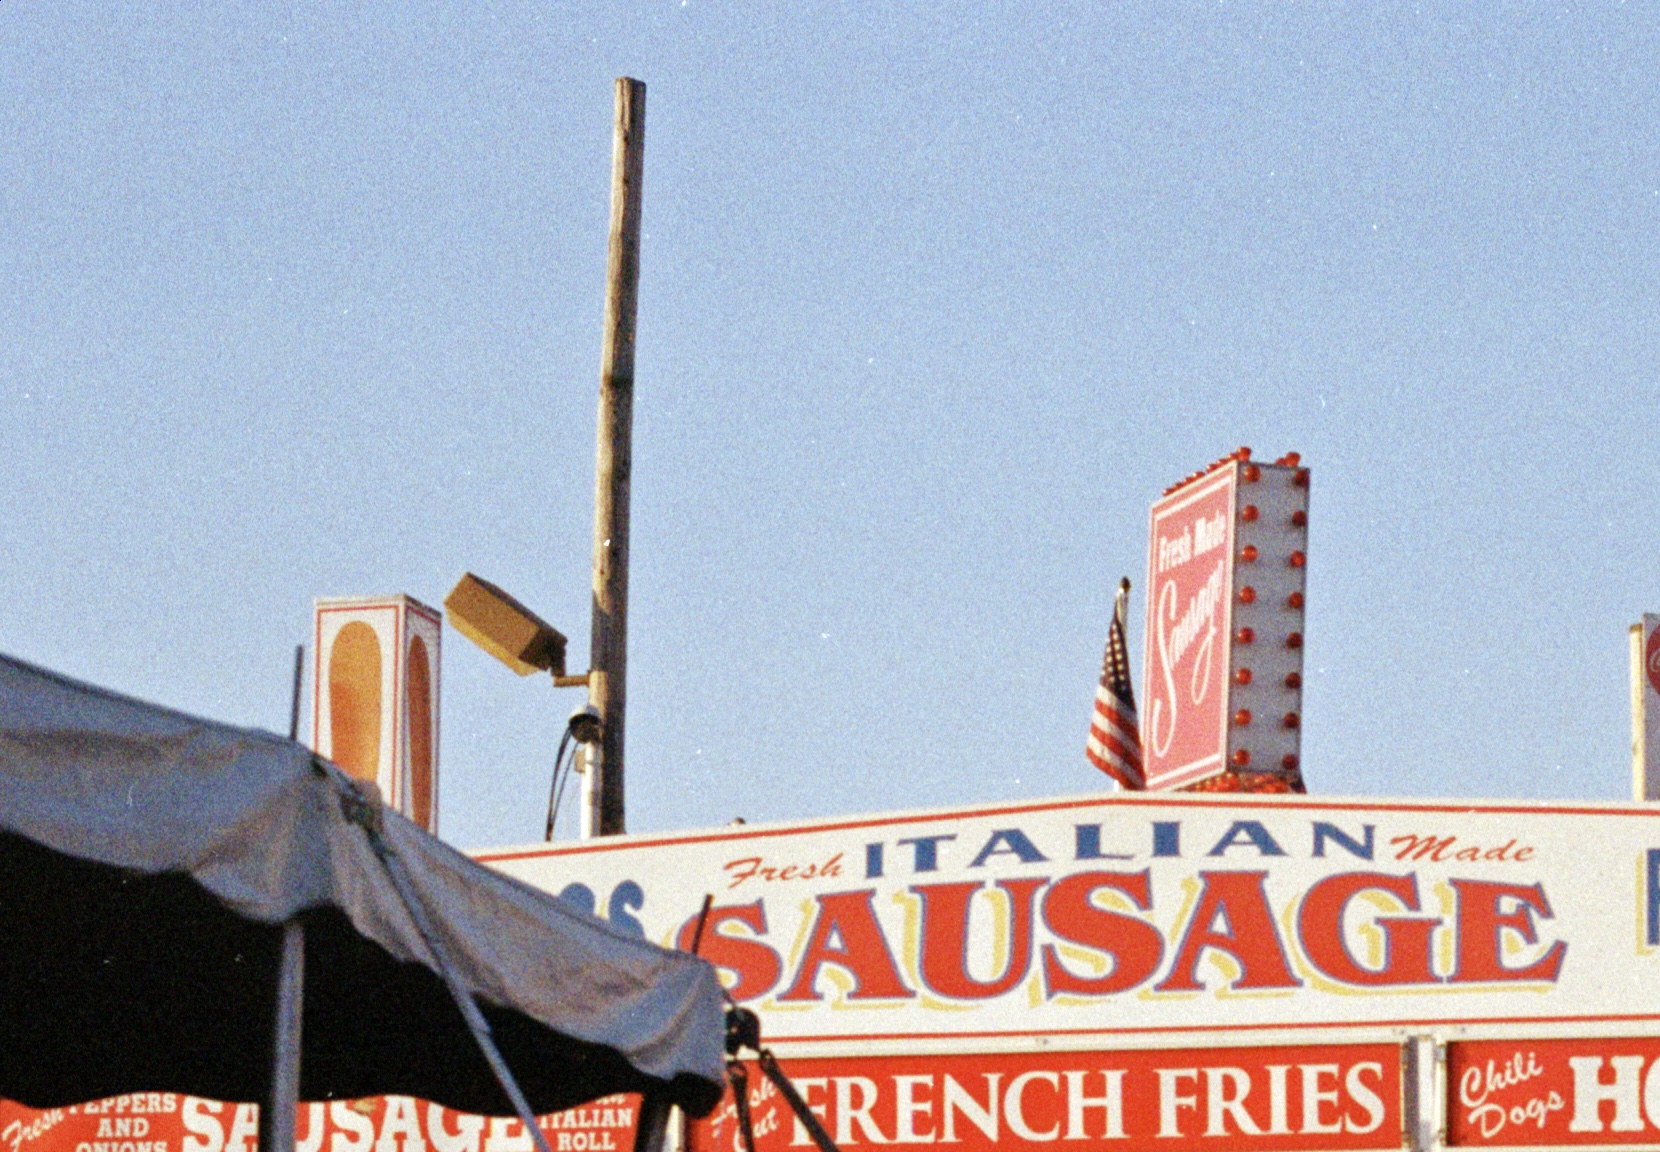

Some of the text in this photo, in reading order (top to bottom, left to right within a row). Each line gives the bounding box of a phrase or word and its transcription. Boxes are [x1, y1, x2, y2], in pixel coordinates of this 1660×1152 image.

[724, 820, 1537, 888] Fresh ITALIAN Made
[676, 867, 1569, 1002] SAUSAGE
[788, 1060, 1385, 1147] FRENCH FRIES
[1460, 1051, 1543, 1108] Chili
[97, 1117, 149, 1138] AND
[557, 1132, 616, 1152] ROLL
[1469, 1090, 1565, 1139] Dogs
